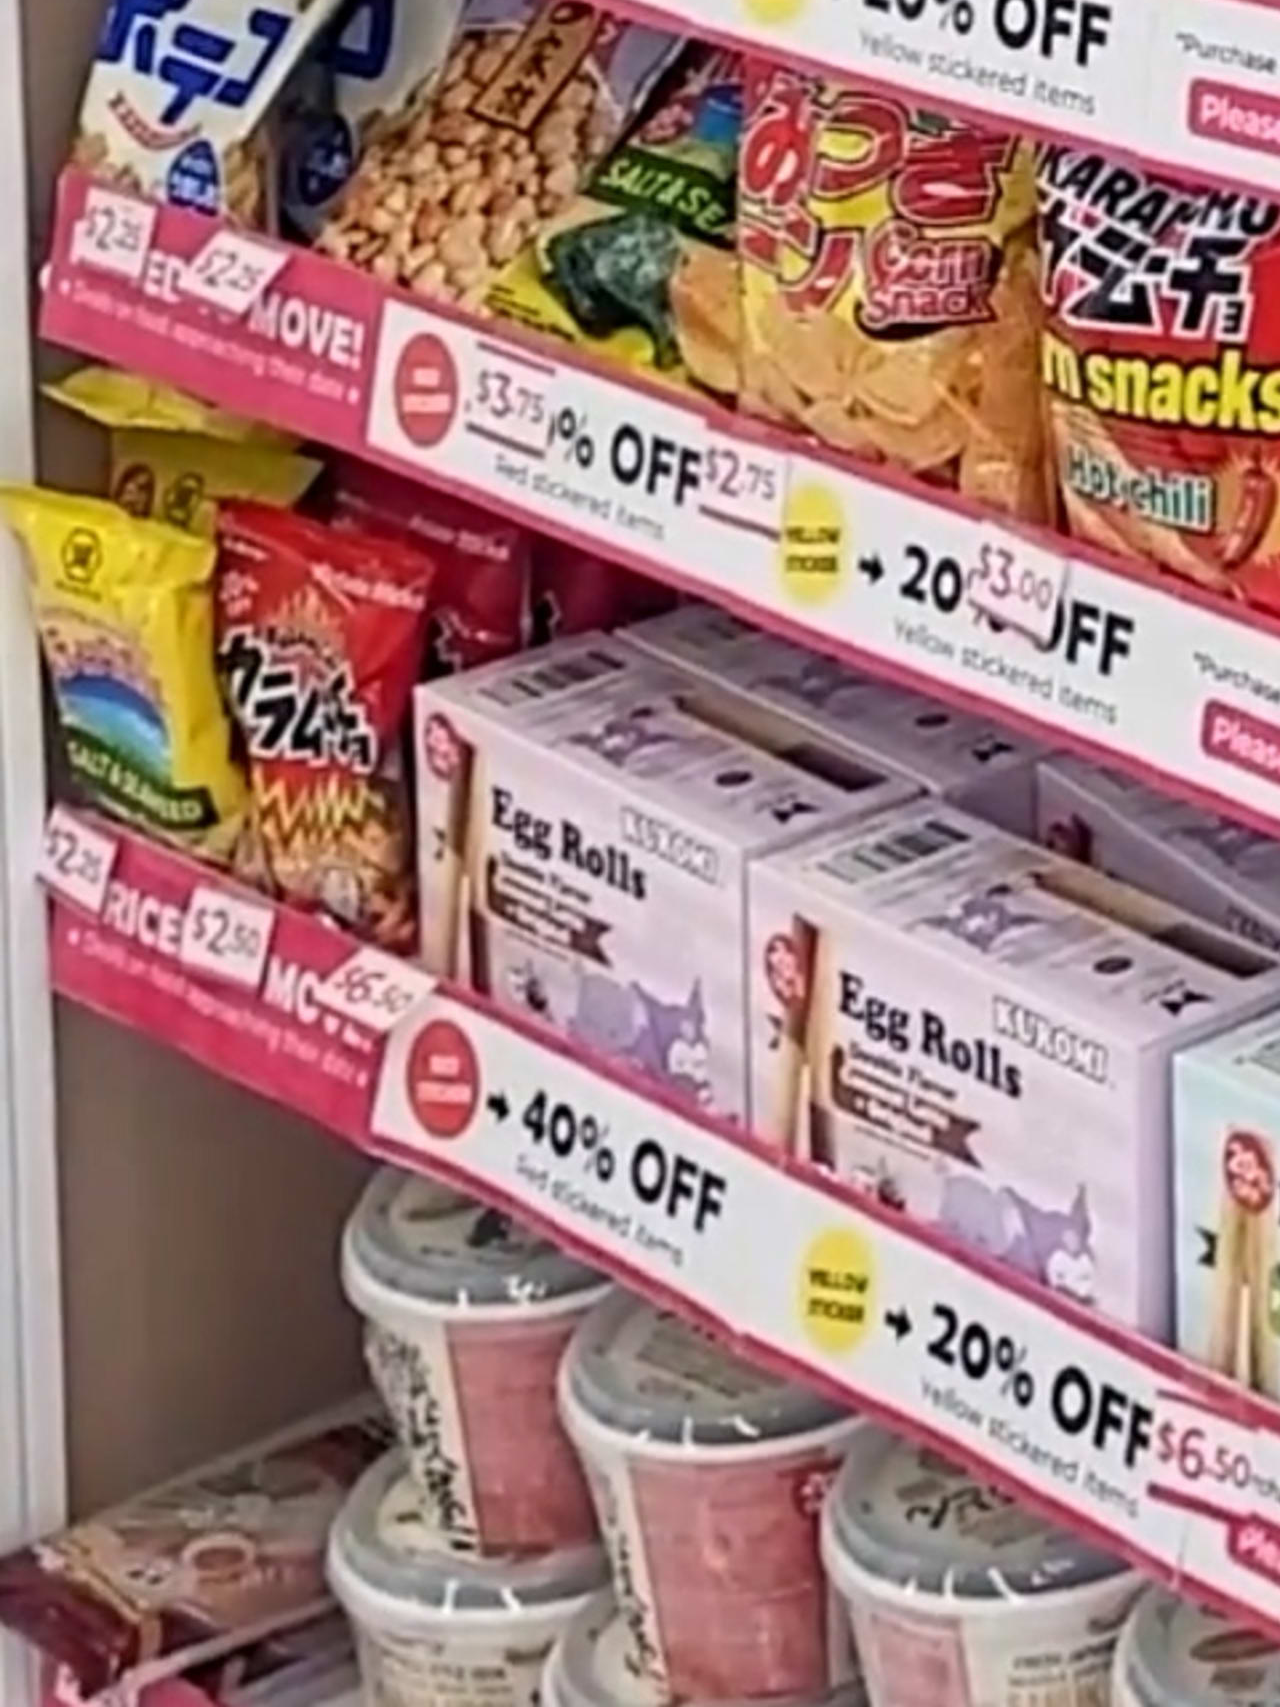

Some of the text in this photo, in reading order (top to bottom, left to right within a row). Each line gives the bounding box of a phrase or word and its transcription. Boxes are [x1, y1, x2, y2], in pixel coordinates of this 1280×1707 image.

[926, 45, 1028, 97] stickered
[1033, 77, 1096, 117] items
[248, 295, 365, 373] MOVE!
[609, 423, 703, 506] OFF
[490, 786, 647, 901] Egg Rolls
[839, 969, 912, 1057] Egg
[919, 1006, 1024, 1101] Rolls
[521, 1089, 728, 1235] 40% OFF
[927, 1302, 1153, 1472] 20% OFF
[1156, 1424, 1253, 1489] $6.50
